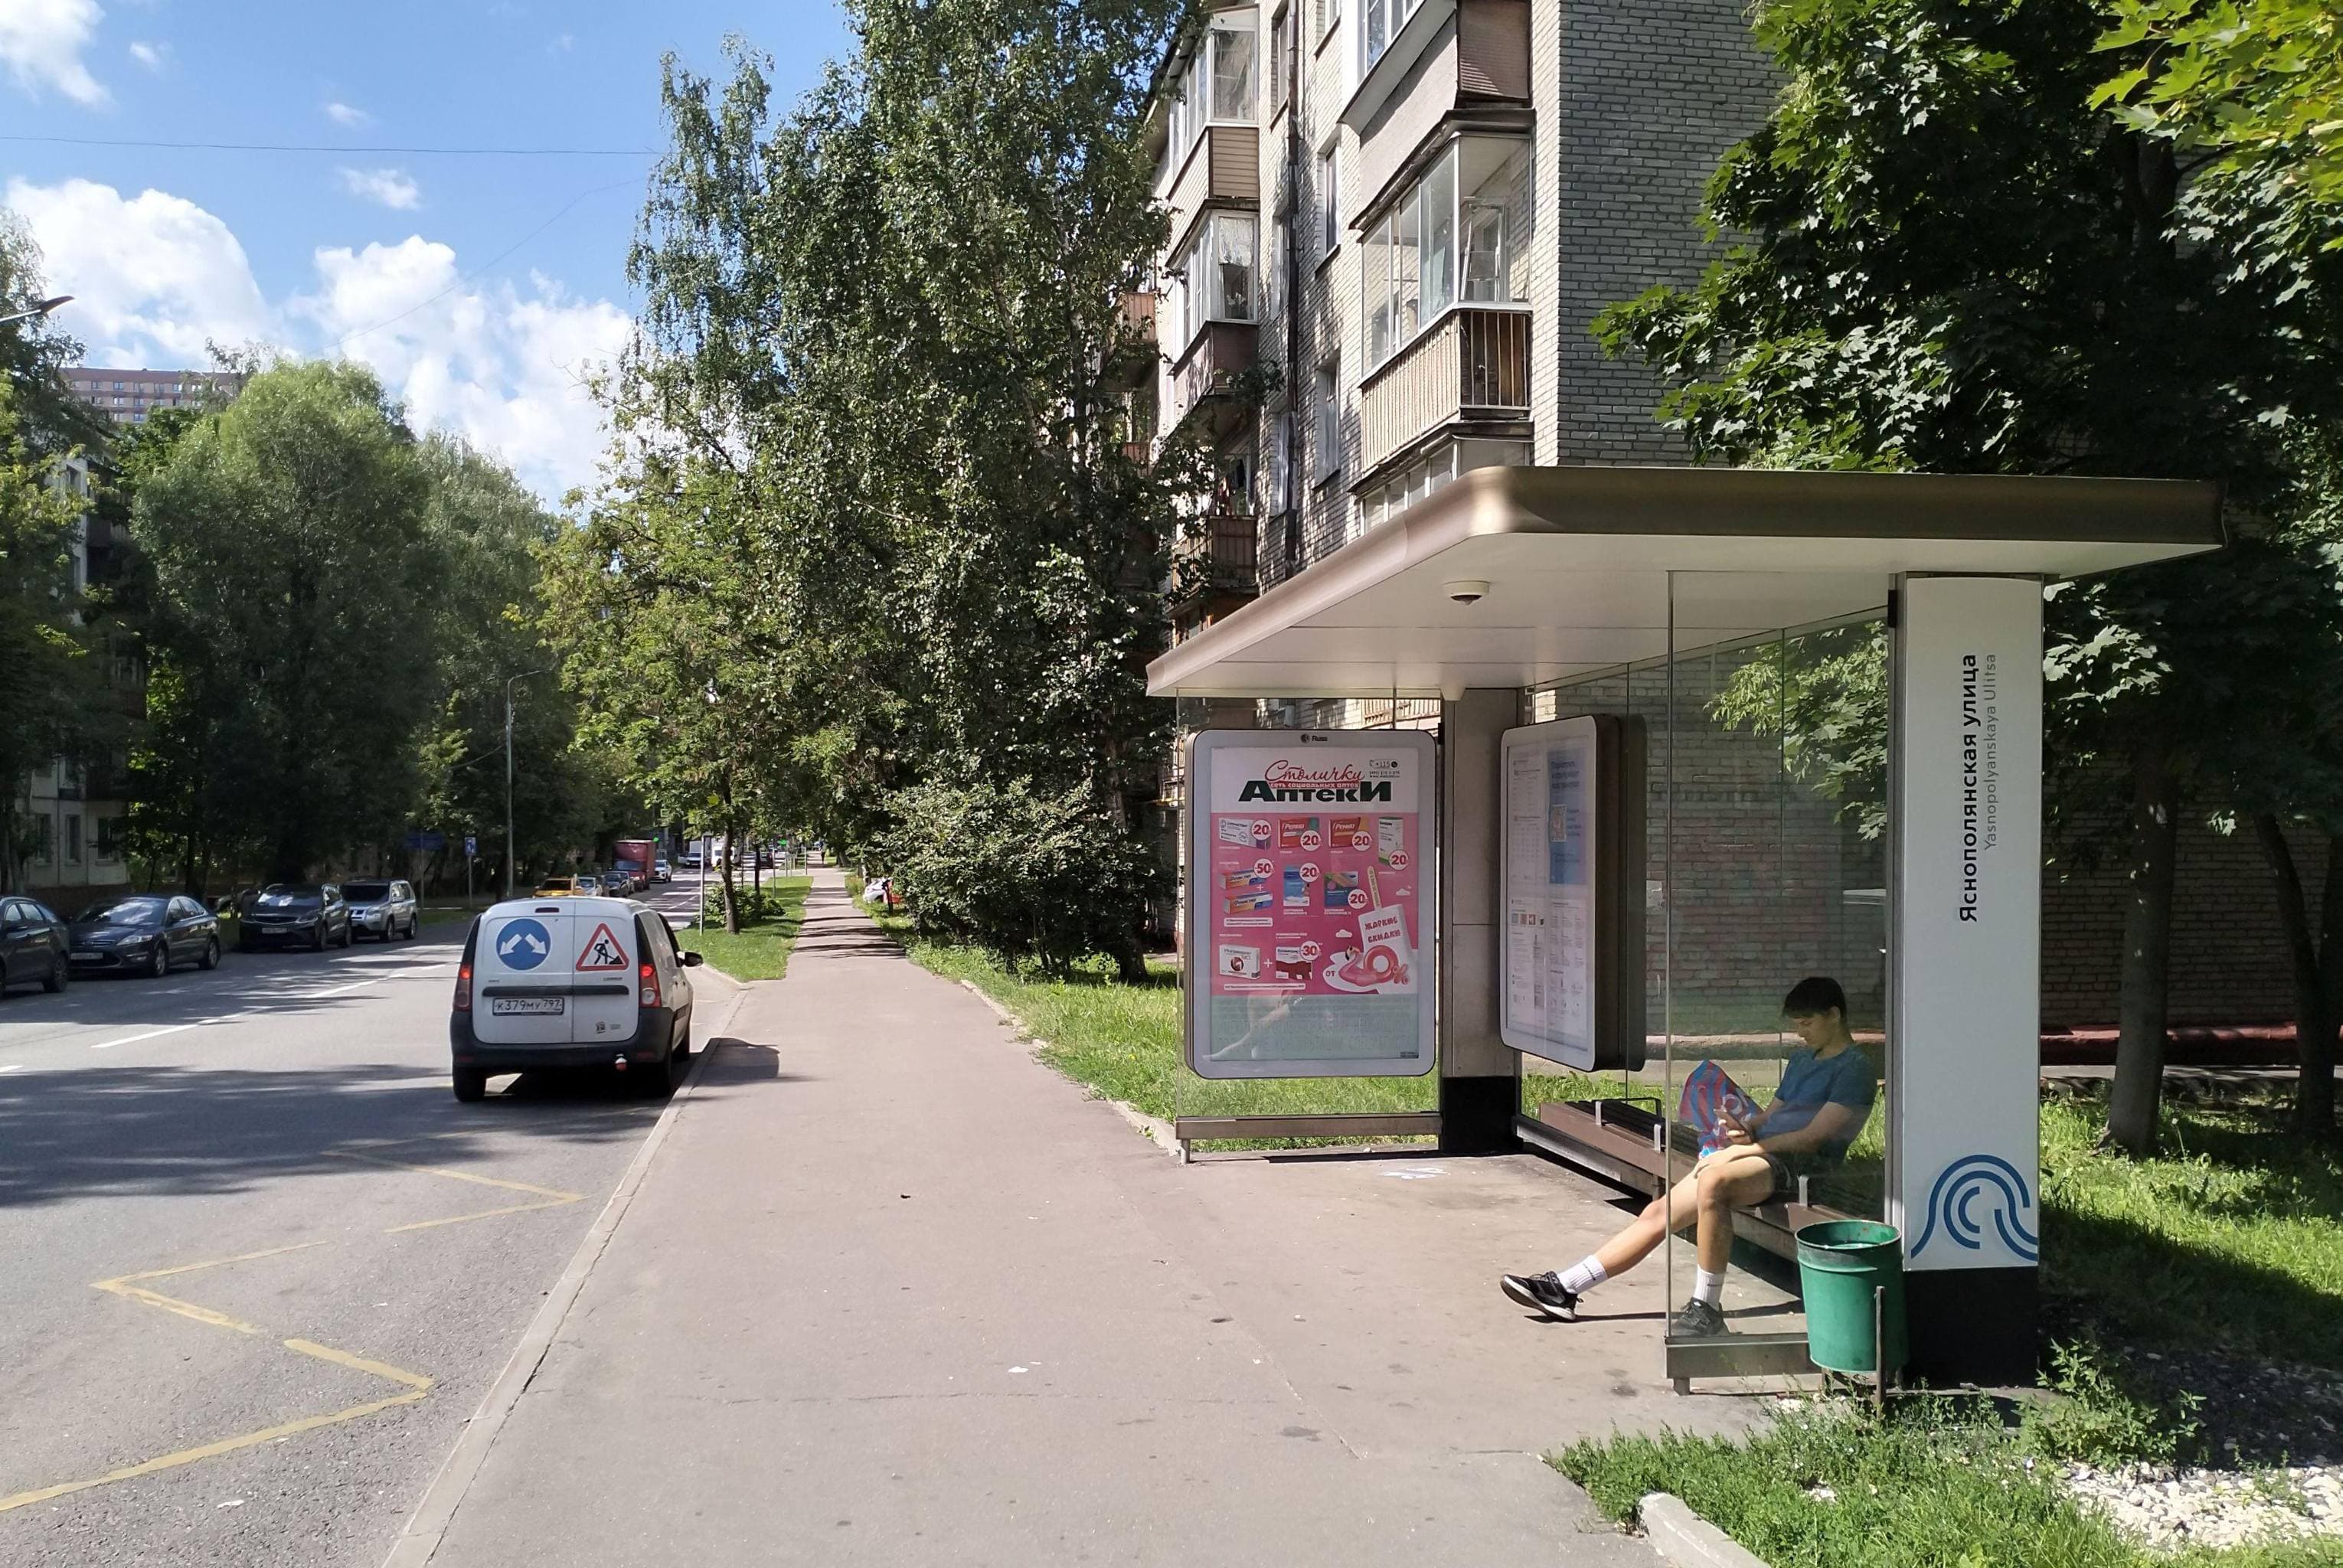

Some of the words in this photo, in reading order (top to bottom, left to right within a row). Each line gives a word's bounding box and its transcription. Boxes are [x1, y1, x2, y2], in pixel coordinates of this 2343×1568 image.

[1962, 655, 1981, 727] улица
[1983, 654, 1997, 701] Ulitsa
[1265, 760, 1365, 782] Столички
[1983, 705, 1999, 851] Yasnopolyanskaya
[1959, 733, 1978, 923] Яснополянская
[1364, 916, 1398, 930] ЖАРКИЕ
[1368, 929, 1401, 943] СКИДКИ
